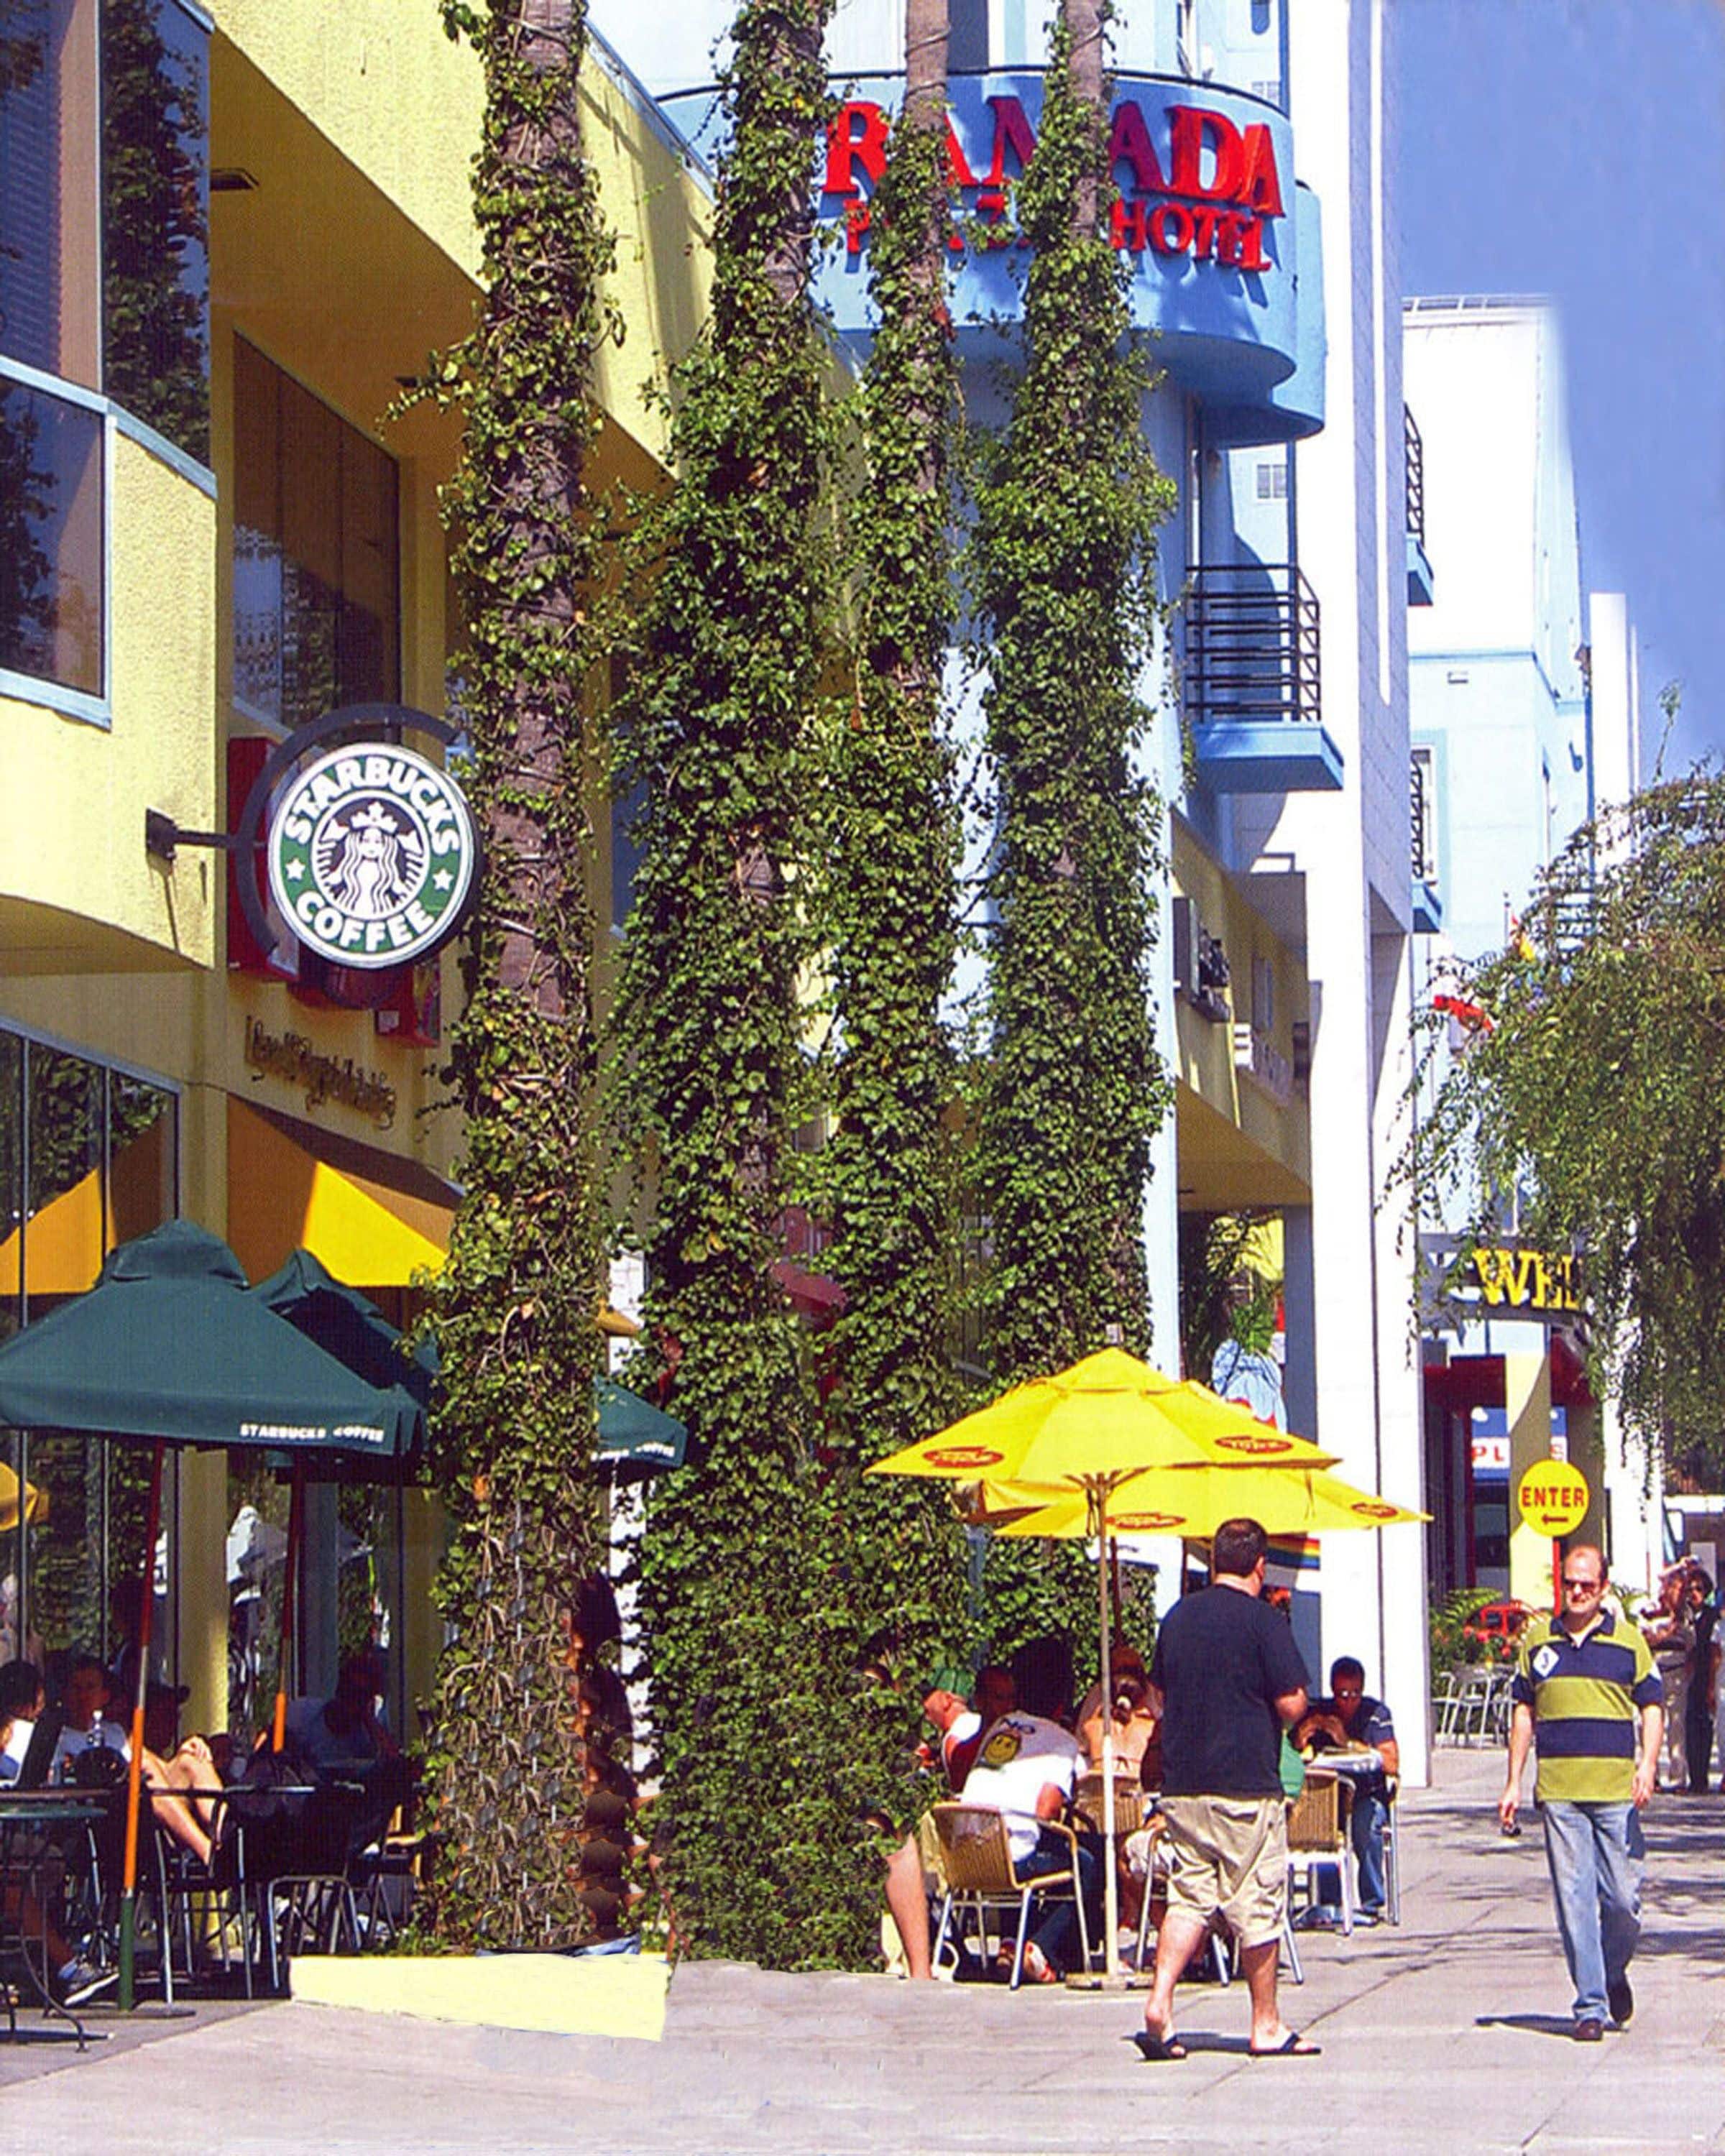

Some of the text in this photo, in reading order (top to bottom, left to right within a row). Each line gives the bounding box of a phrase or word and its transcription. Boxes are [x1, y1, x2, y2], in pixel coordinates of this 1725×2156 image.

[1108, 199, 1272, 272] HOTEL
[284, 756, 460, 855] STARBUCKS
[295, 890, 435, 953] COFFEE
[239, 1423, 385, 1442] STARBUCKS COFFEE
[1522, 1486, 1585, 1508] ENTER
